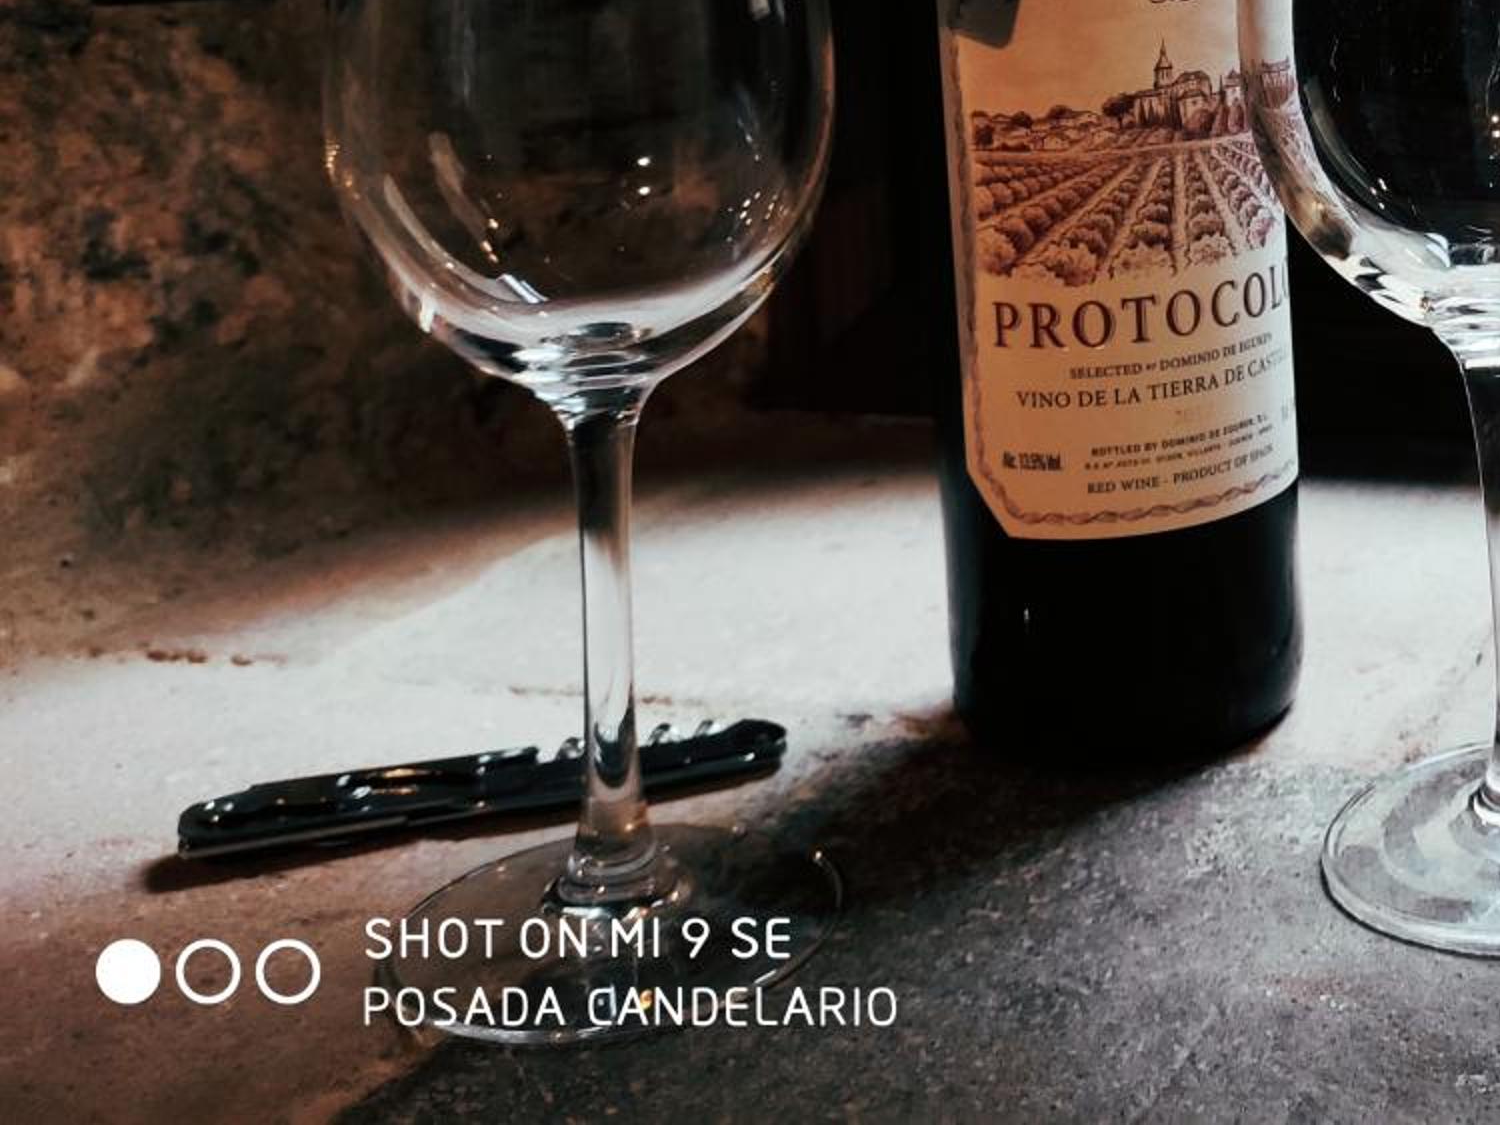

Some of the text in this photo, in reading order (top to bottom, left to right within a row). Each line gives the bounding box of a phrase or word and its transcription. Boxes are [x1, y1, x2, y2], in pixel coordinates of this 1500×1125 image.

[1070, 362, 1142, 379] SELECTED
[1159, 348, 1220, 371] DOMINIO
[1223, 343, 1237, 359] DE
[1016, 390, 1071, 409] VINO
[1078, 389, 1107, 408] DE
[1114, 388, 1141, 406] LA
[1147, 375, 1219, 401] TIERRA
[1224, 366, 1245, 385] DE
[1087, 477, 1116, 494] RED
[1121, 476, 1160, 492] WINE
[1173, 458, 1232, 485] PRODUCT
[1234, 453, 1250, 469] OF
